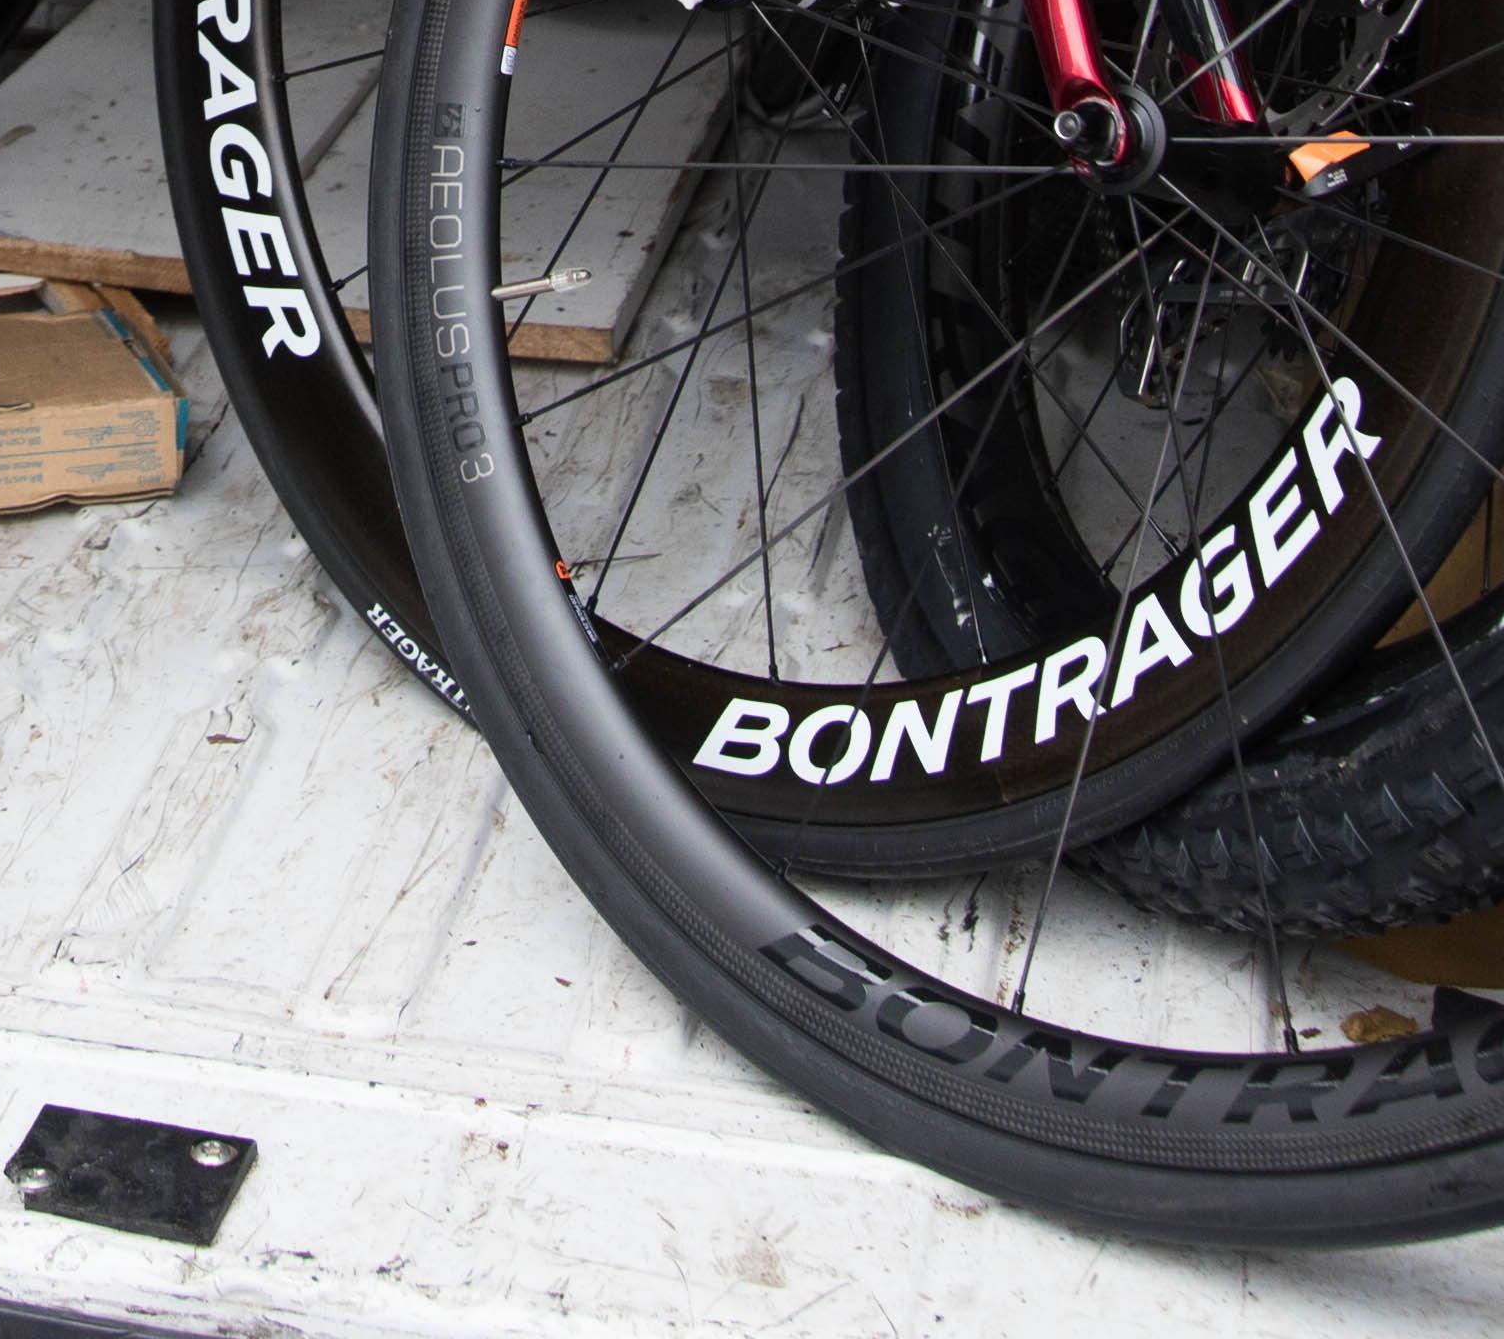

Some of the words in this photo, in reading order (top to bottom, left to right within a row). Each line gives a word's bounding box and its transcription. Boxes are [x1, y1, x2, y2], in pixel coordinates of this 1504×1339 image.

[425, 140, 470, 354] AEOLUS
[442, 354, 484, 449] PRO
[366, 599, 468, 716] TRAGER
[693, 373, 1384, 787] BONTRAGER
